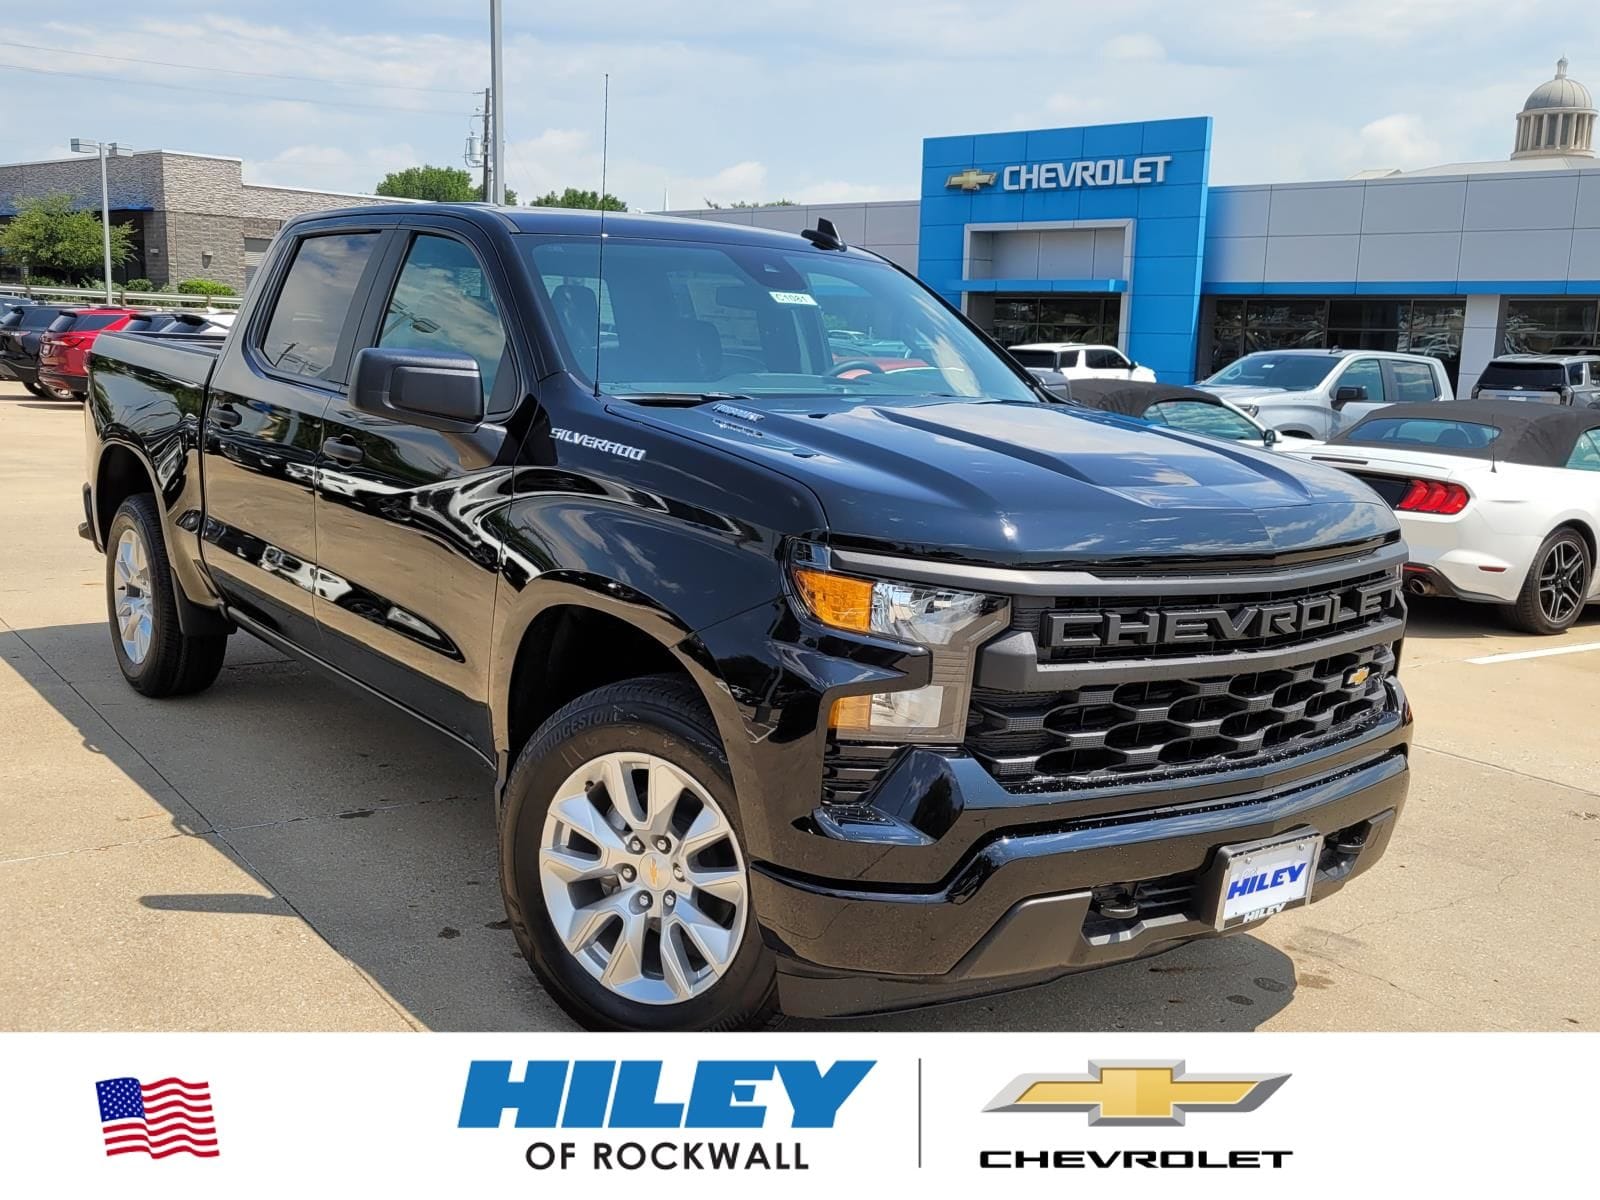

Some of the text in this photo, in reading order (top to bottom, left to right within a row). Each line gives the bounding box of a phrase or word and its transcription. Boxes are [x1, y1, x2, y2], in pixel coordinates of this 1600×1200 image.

[1003, 155, 1172, 191] CHEVROLET
[549, 427, 646, 461] SILVERADO
[1047, 580, 1399, 647] CHEVROLET
[1227, 862, 1307, 900] HILEY
[1243, 902, 1287, 923] HILEY
